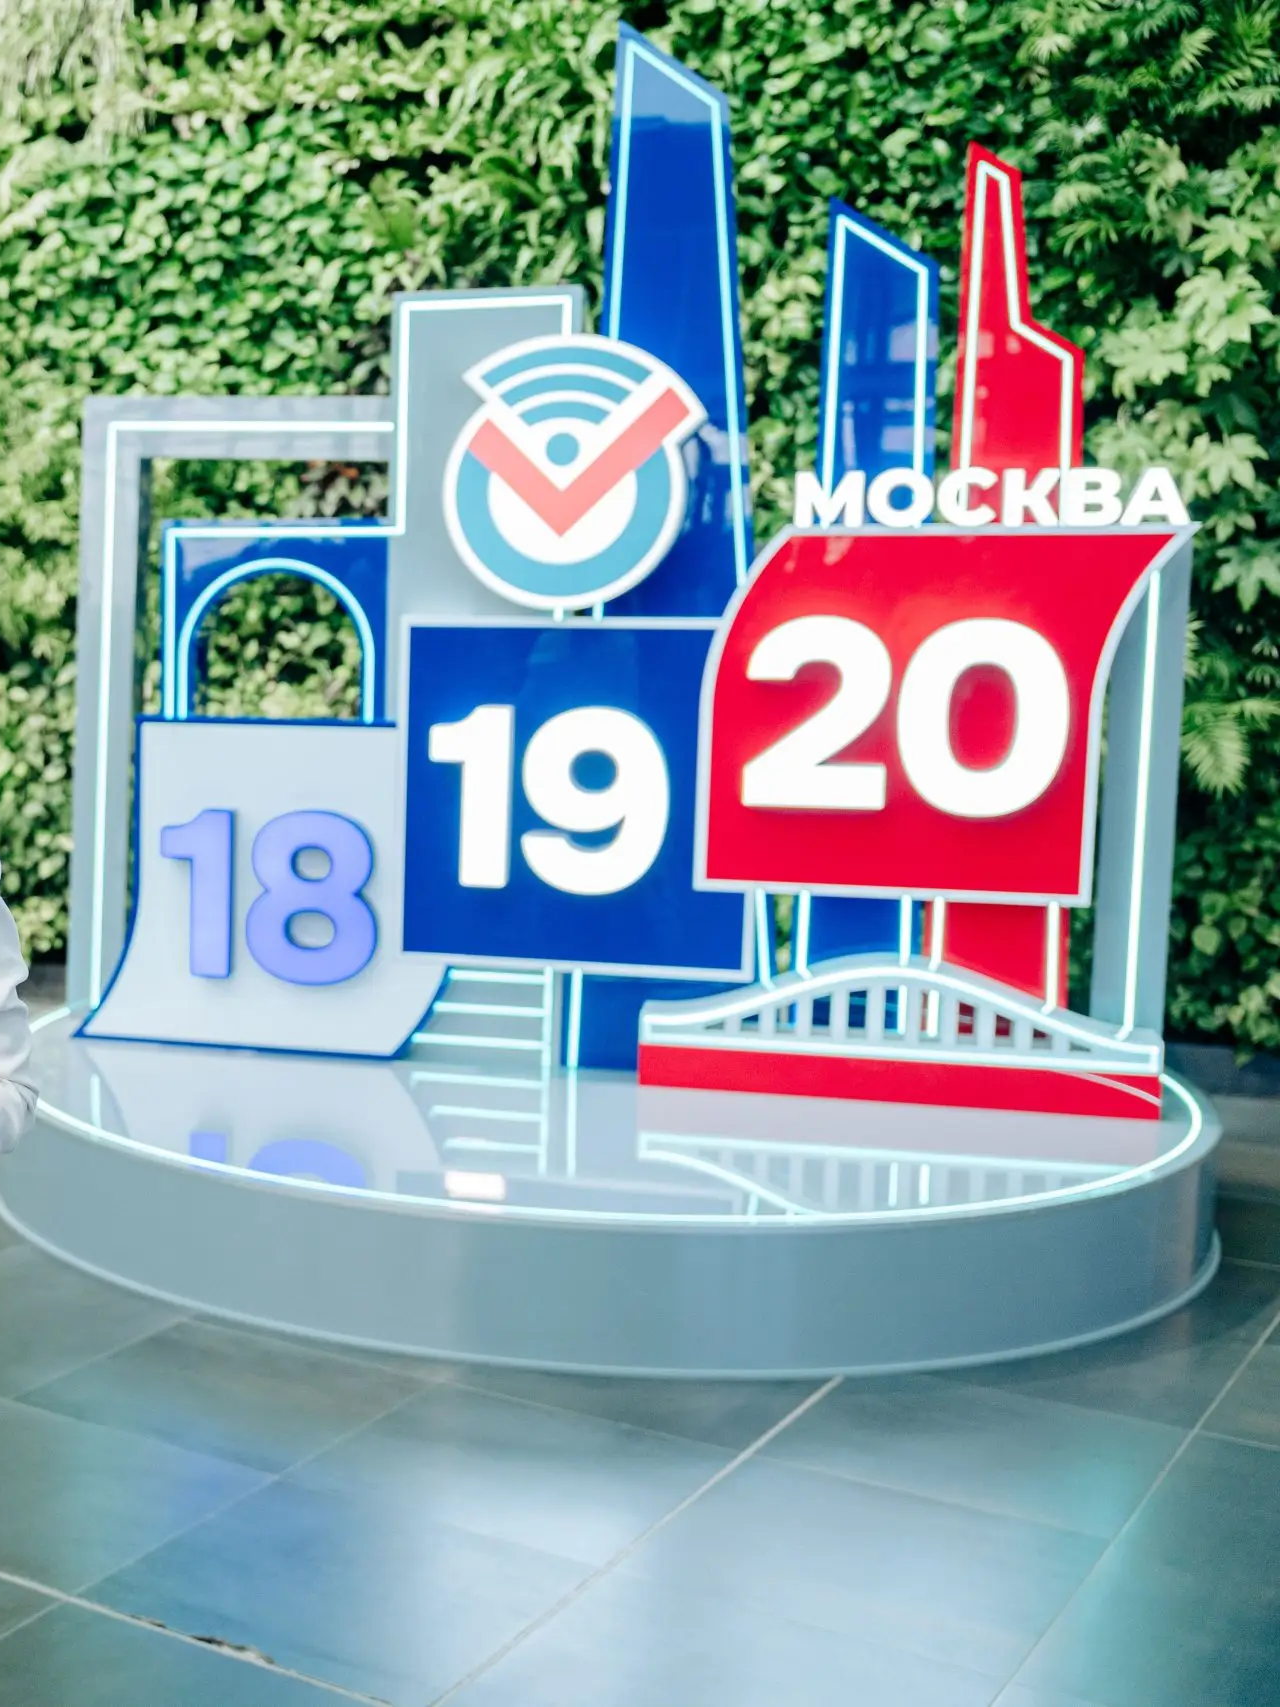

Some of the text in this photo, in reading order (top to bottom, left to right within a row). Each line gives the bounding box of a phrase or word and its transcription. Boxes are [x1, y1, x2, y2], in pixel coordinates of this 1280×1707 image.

[793, 466, 1191, 528] МОСКВА
[428, 704, 670, 896] 19
[740, 614, 1070, 818] 20
[159, 808, 379, 986] 18
